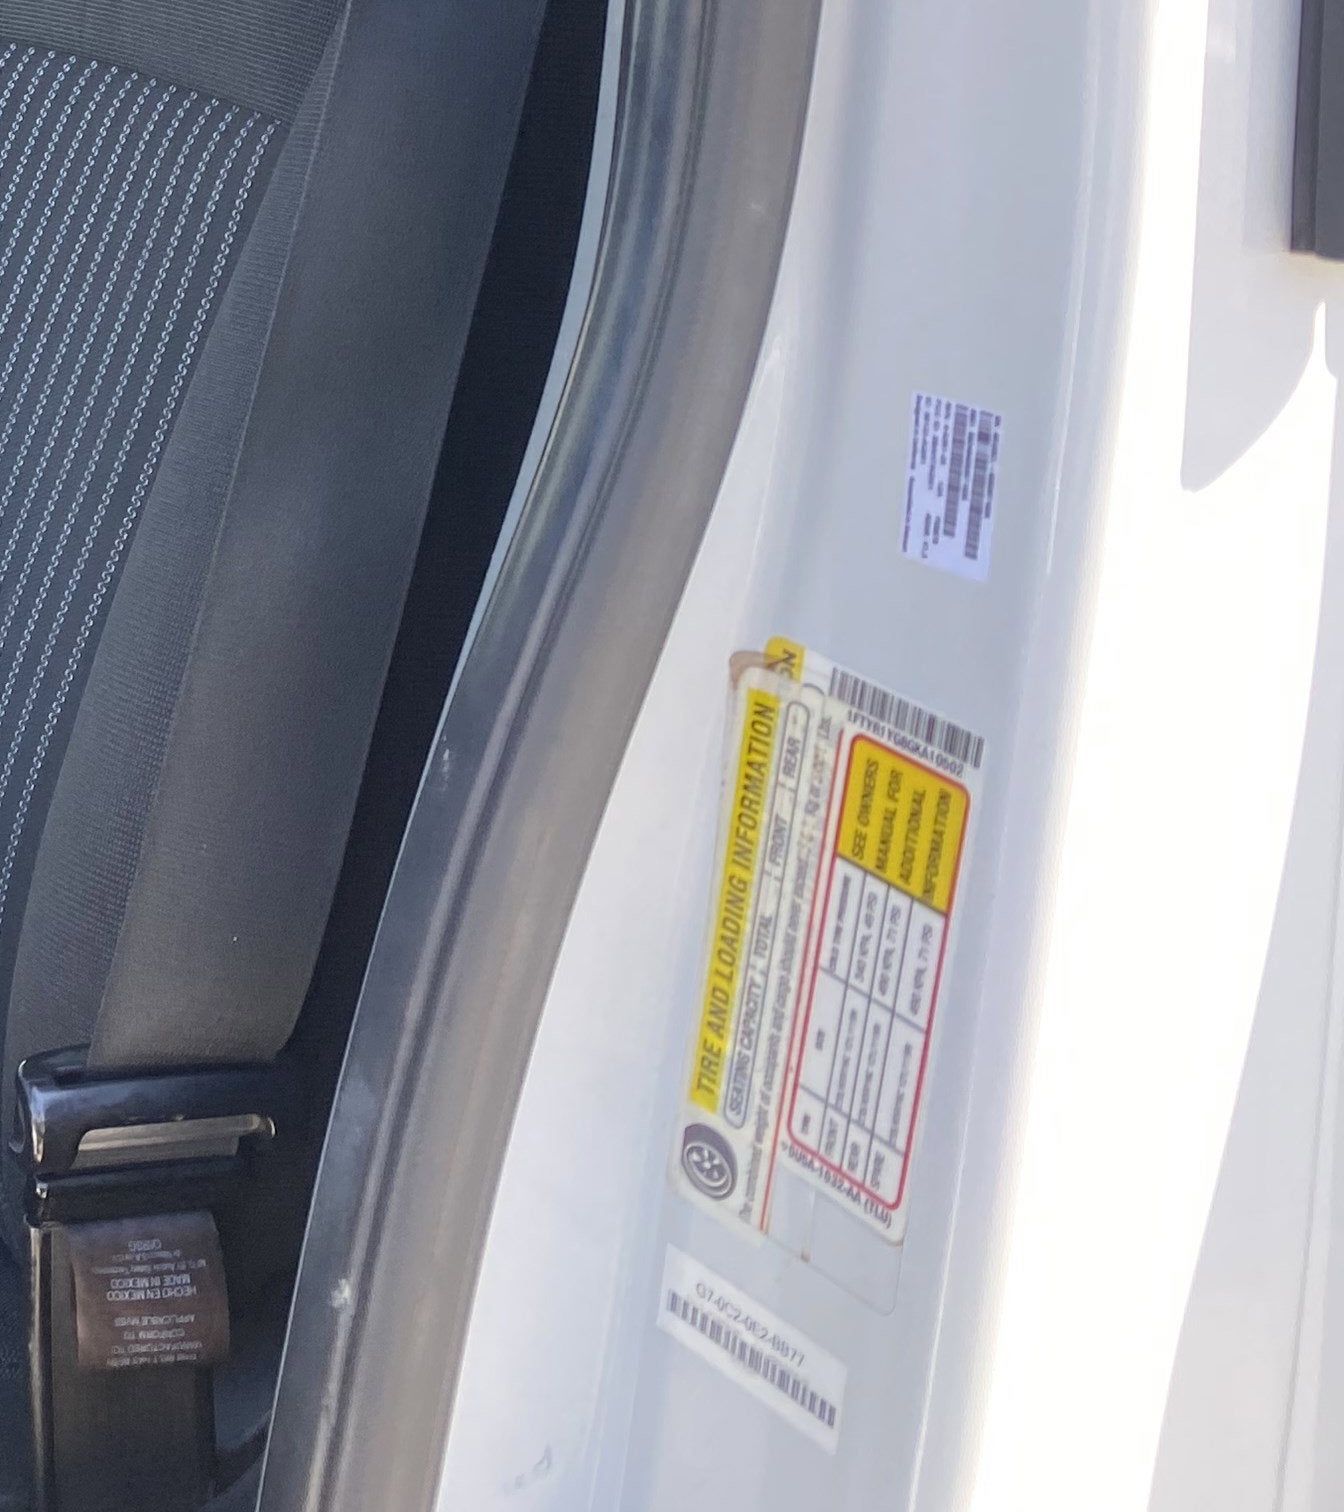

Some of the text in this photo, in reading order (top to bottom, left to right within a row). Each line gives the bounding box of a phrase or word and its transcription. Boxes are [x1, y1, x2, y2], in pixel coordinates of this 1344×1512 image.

[850, 825, 868, 862] SEE
[873, 766, 904, 874] MANUAL FOR
[896, 784, 926, 886] ADDITIONAL
[920, 787, 953, 903] INFORMATION
[696, 698, 776, 1097] TIRE AND LOADING INFORMATION
[739, 976, 763, 1052] CAPACITY
[753, 911, 773, 960] TOTAL
[768, 811, 788, 867] FRONT
[781, 734, 801, 780] REAR
[106, 1289, 145, 1301] MEXICO
[110, 1273, 191, 1289] MADE IN MEXICO
[146, 1289, 161, 1299] EN
